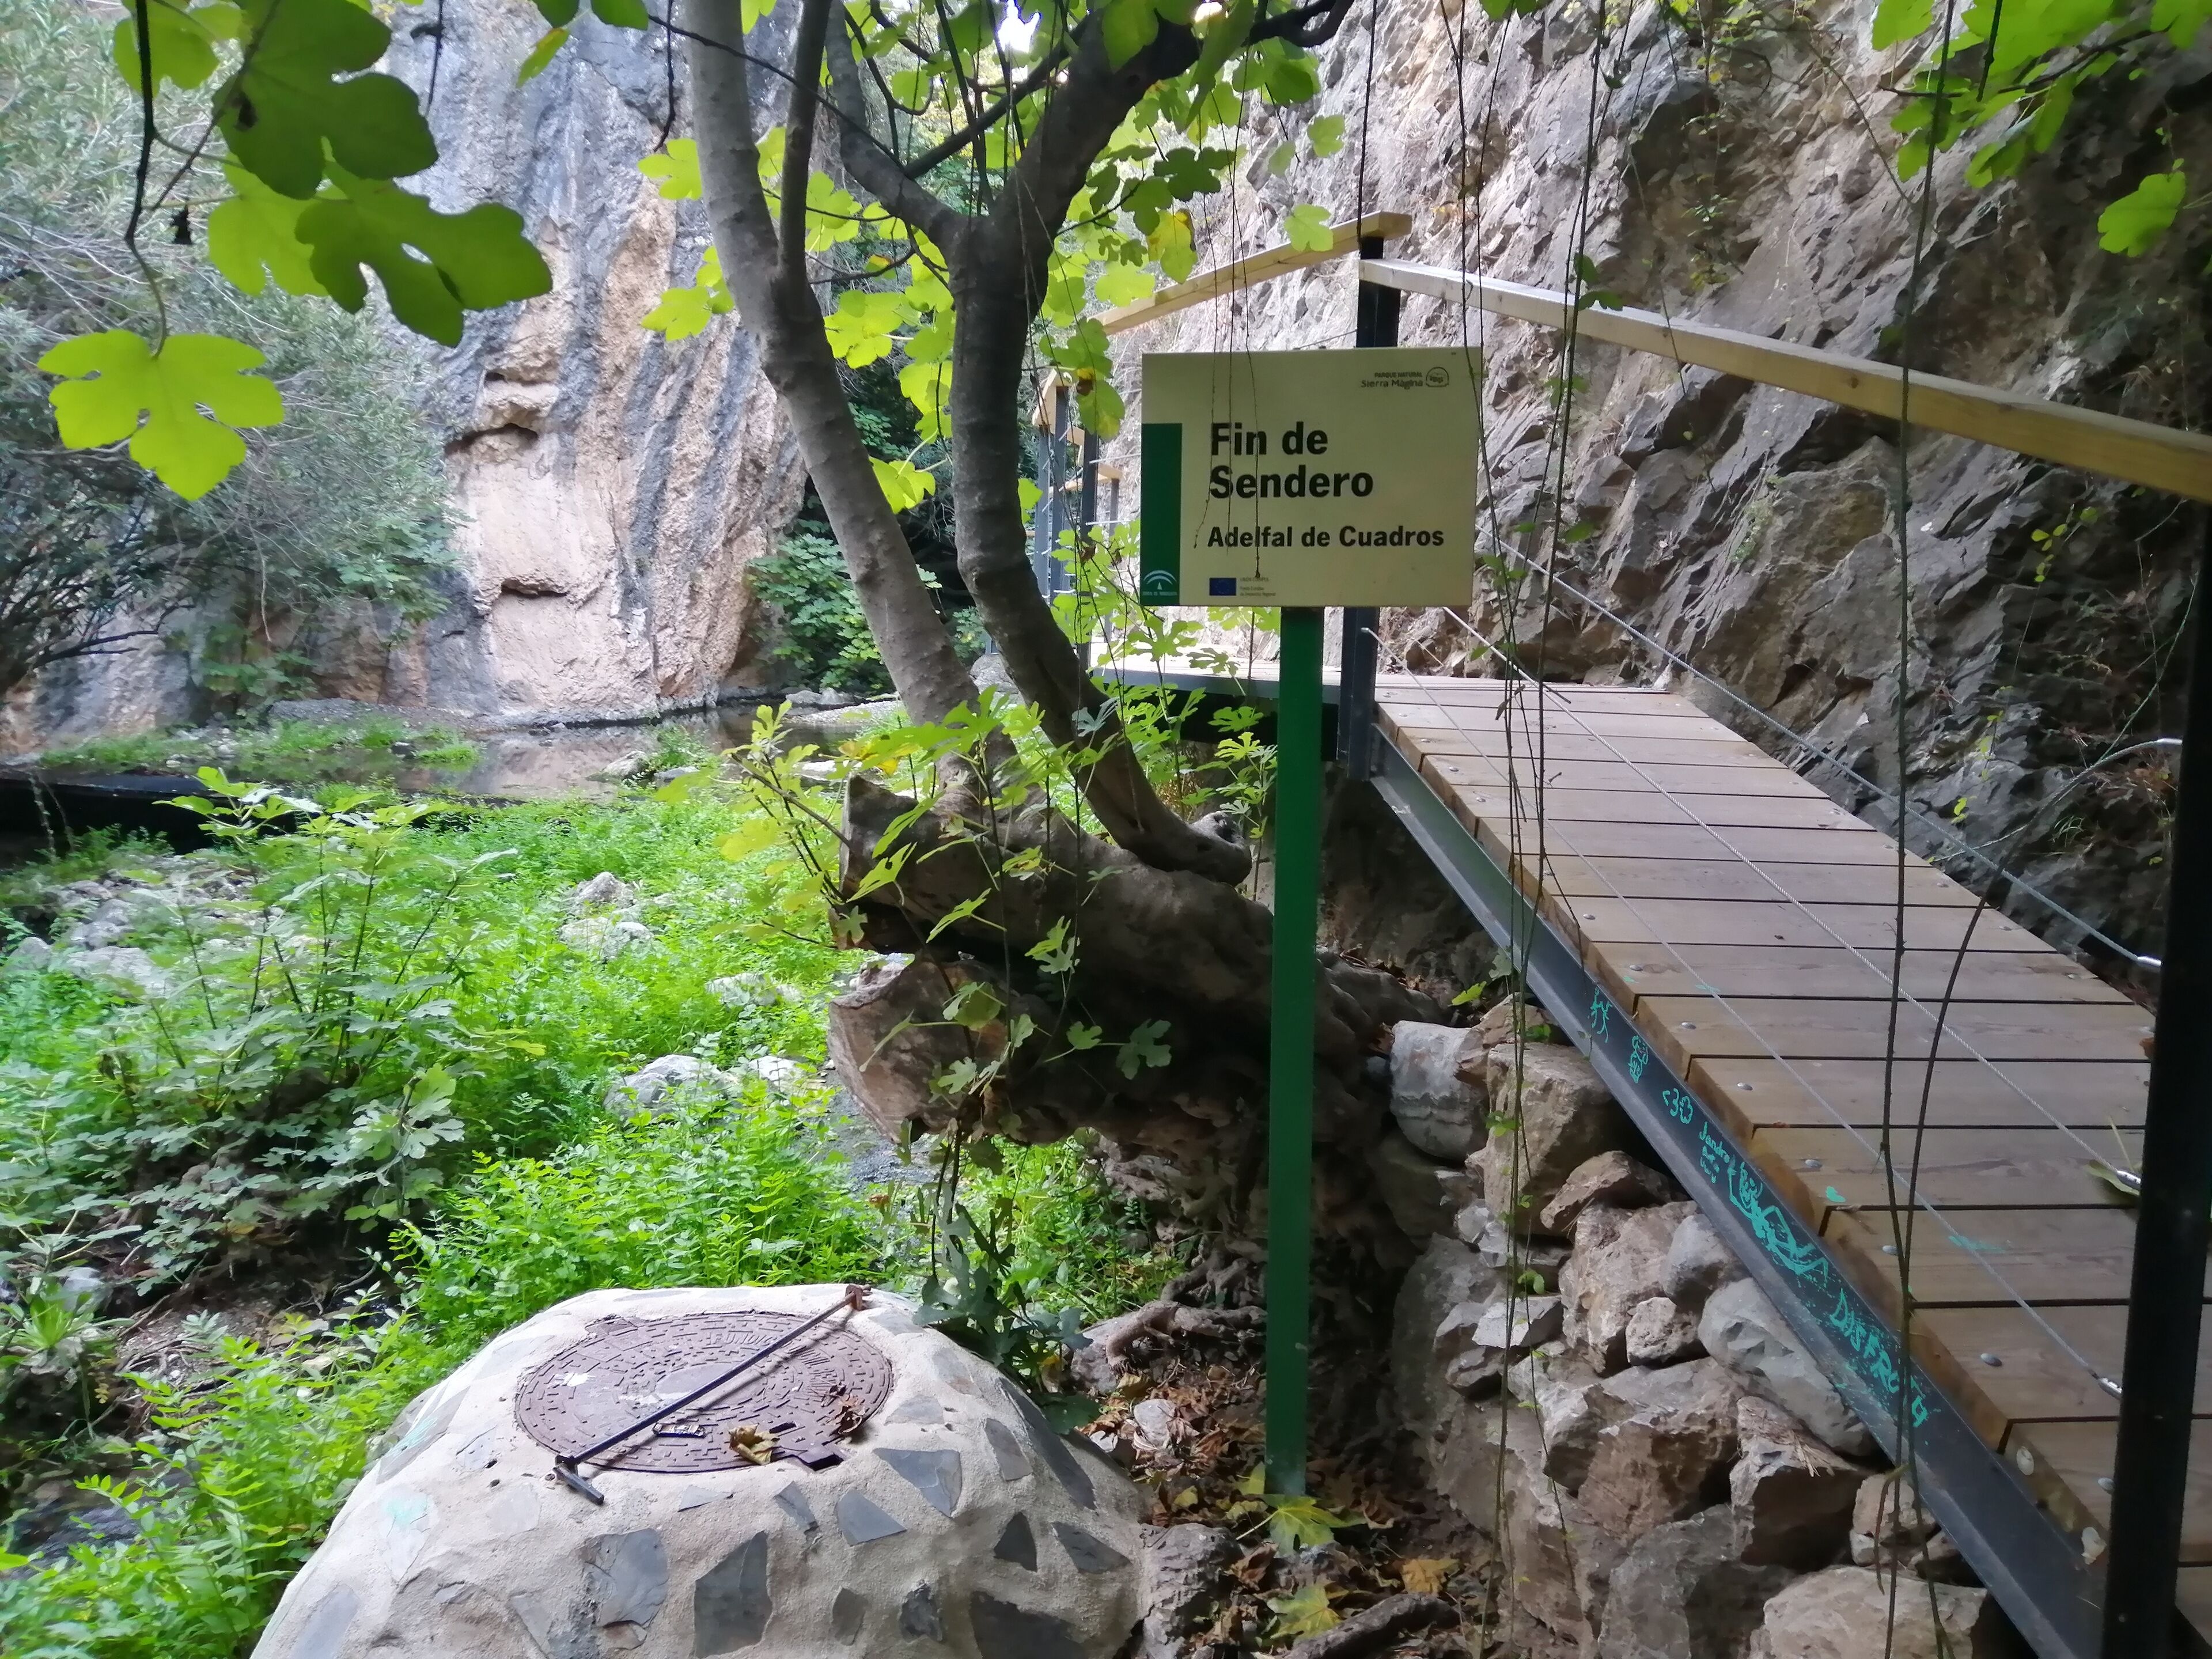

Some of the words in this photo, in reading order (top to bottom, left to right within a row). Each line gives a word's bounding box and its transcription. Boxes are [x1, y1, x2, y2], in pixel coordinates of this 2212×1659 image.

[1211, 422, 1267, 456] Fin
[1282, 421, 1328, 455] de
[1210, 465, 1373, 498] Sendero
[1207, 527, 1292, 547] Adelfal
[1301, 527, 1331, 547] de
[1339, 525, 1445, 546] Cuadros
